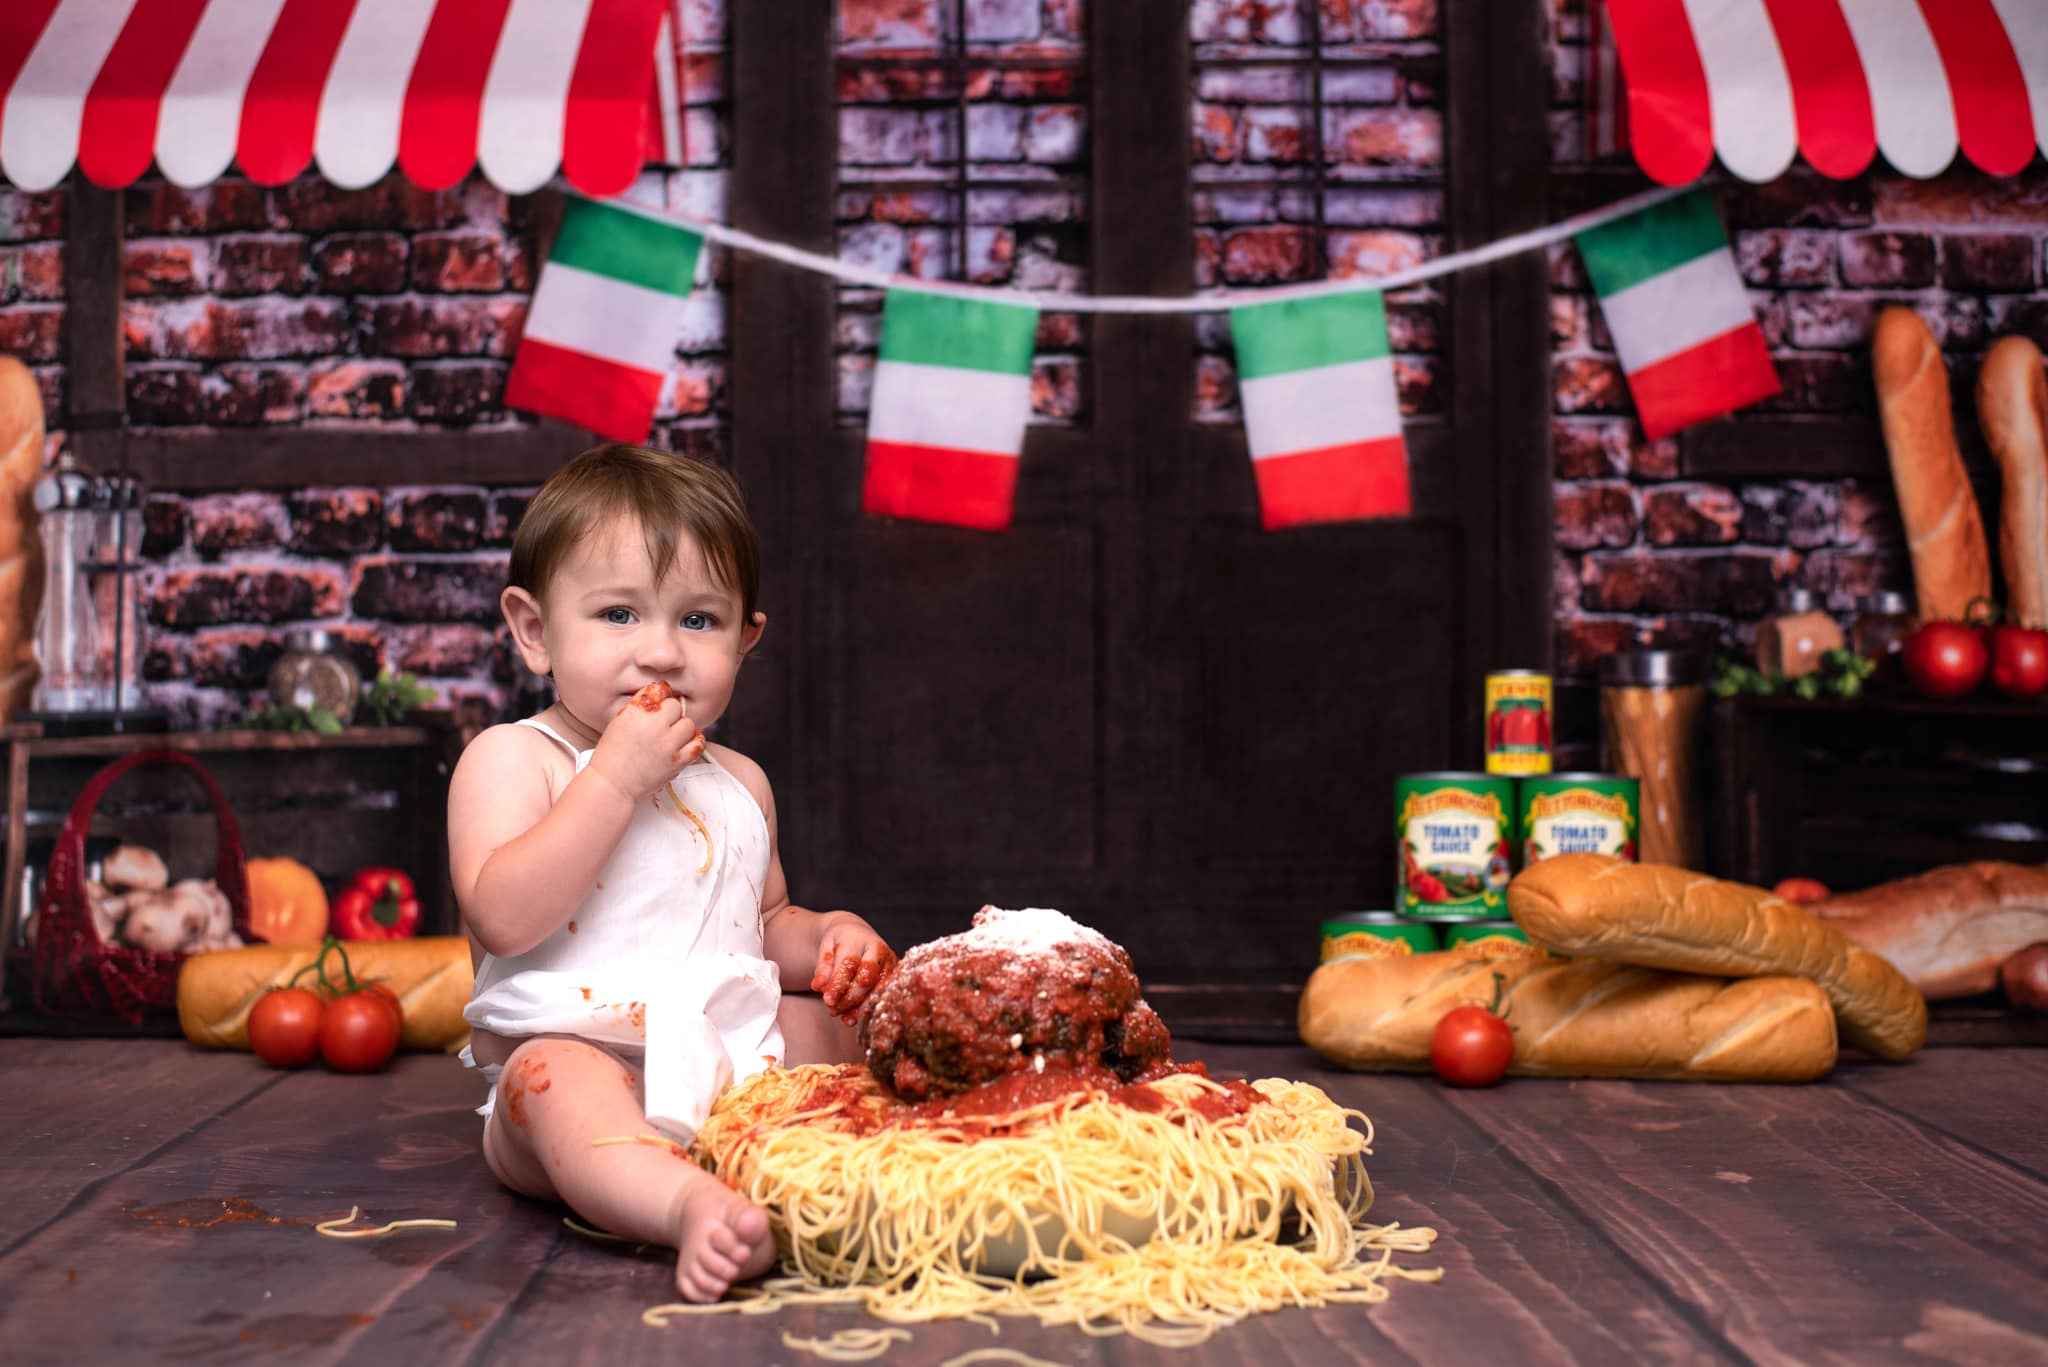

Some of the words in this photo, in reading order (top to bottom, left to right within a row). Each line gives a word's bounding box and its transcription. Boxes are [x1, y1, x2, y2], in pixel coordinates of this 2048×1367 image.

[1424, 825, 1480, 838] TOMATO
[1551, 826, 1608, 840] TOMATO
[1432, 841, 1471, 853] SAUCE
[1558, 843, 1600, 856] SAUCE
